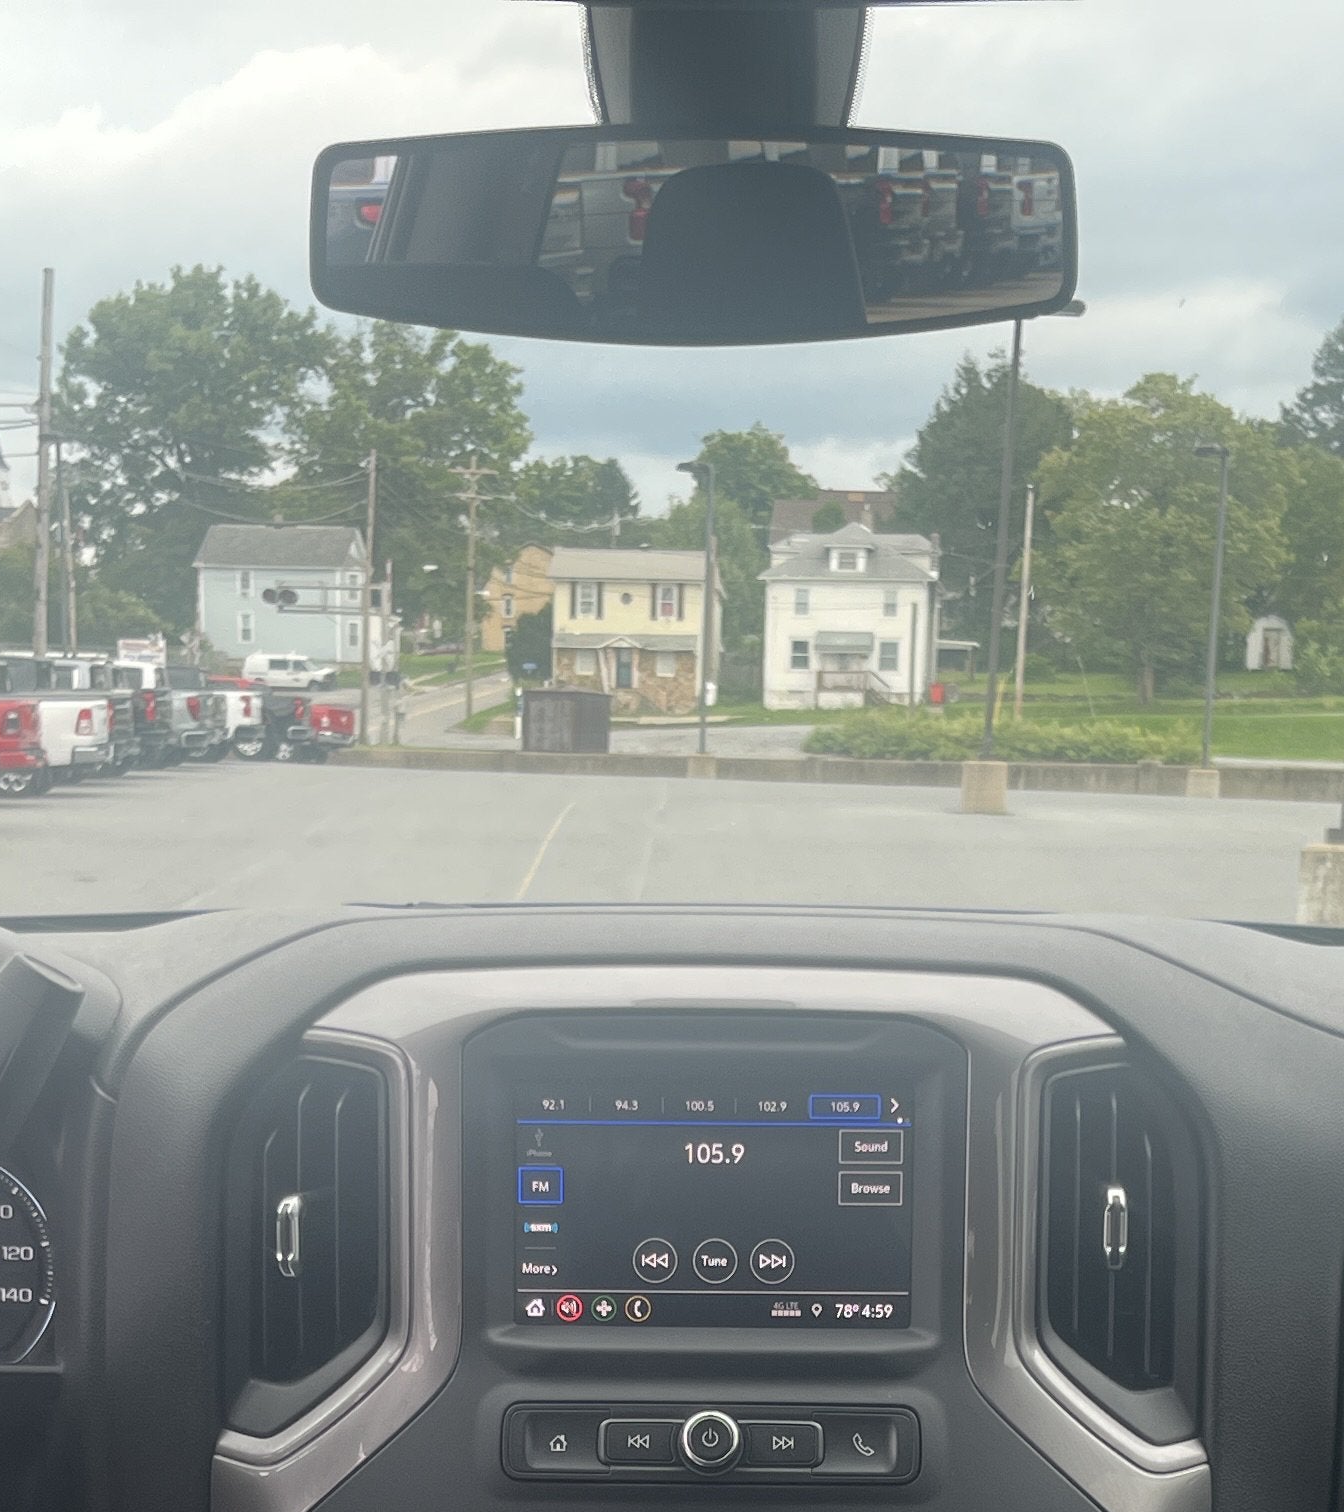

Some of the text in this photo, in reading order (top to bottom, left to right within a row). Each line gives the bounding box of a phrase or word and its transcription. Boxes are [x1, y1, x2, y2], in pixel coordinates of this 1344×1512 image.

[541, 1099, 566, 1111] 92.1
[615, 1100, 639, 1111] 94.3
[684, 1100, 715, 1112] 100.5
[758, 1101, 788, 1112] 102.9
[831, 1101, 860, 1112] 105.9
[854, 1140, 889, 1153] Sound
[684, 1142, 745, 1164] 105.9
[531, 1181, 550, 1193] FM
[851, 1182, 891, 1194] Browse
[2, 1246, 34, 1261] 120
[701, 1254, 728, 1267] Tune
[522, 1262, 551, 1274] More
[0, 1288, 33, 1302] 140
[773, 1302, 799, 1310] 4G LTE
[861, 1304, 893, 1318] 4:59
